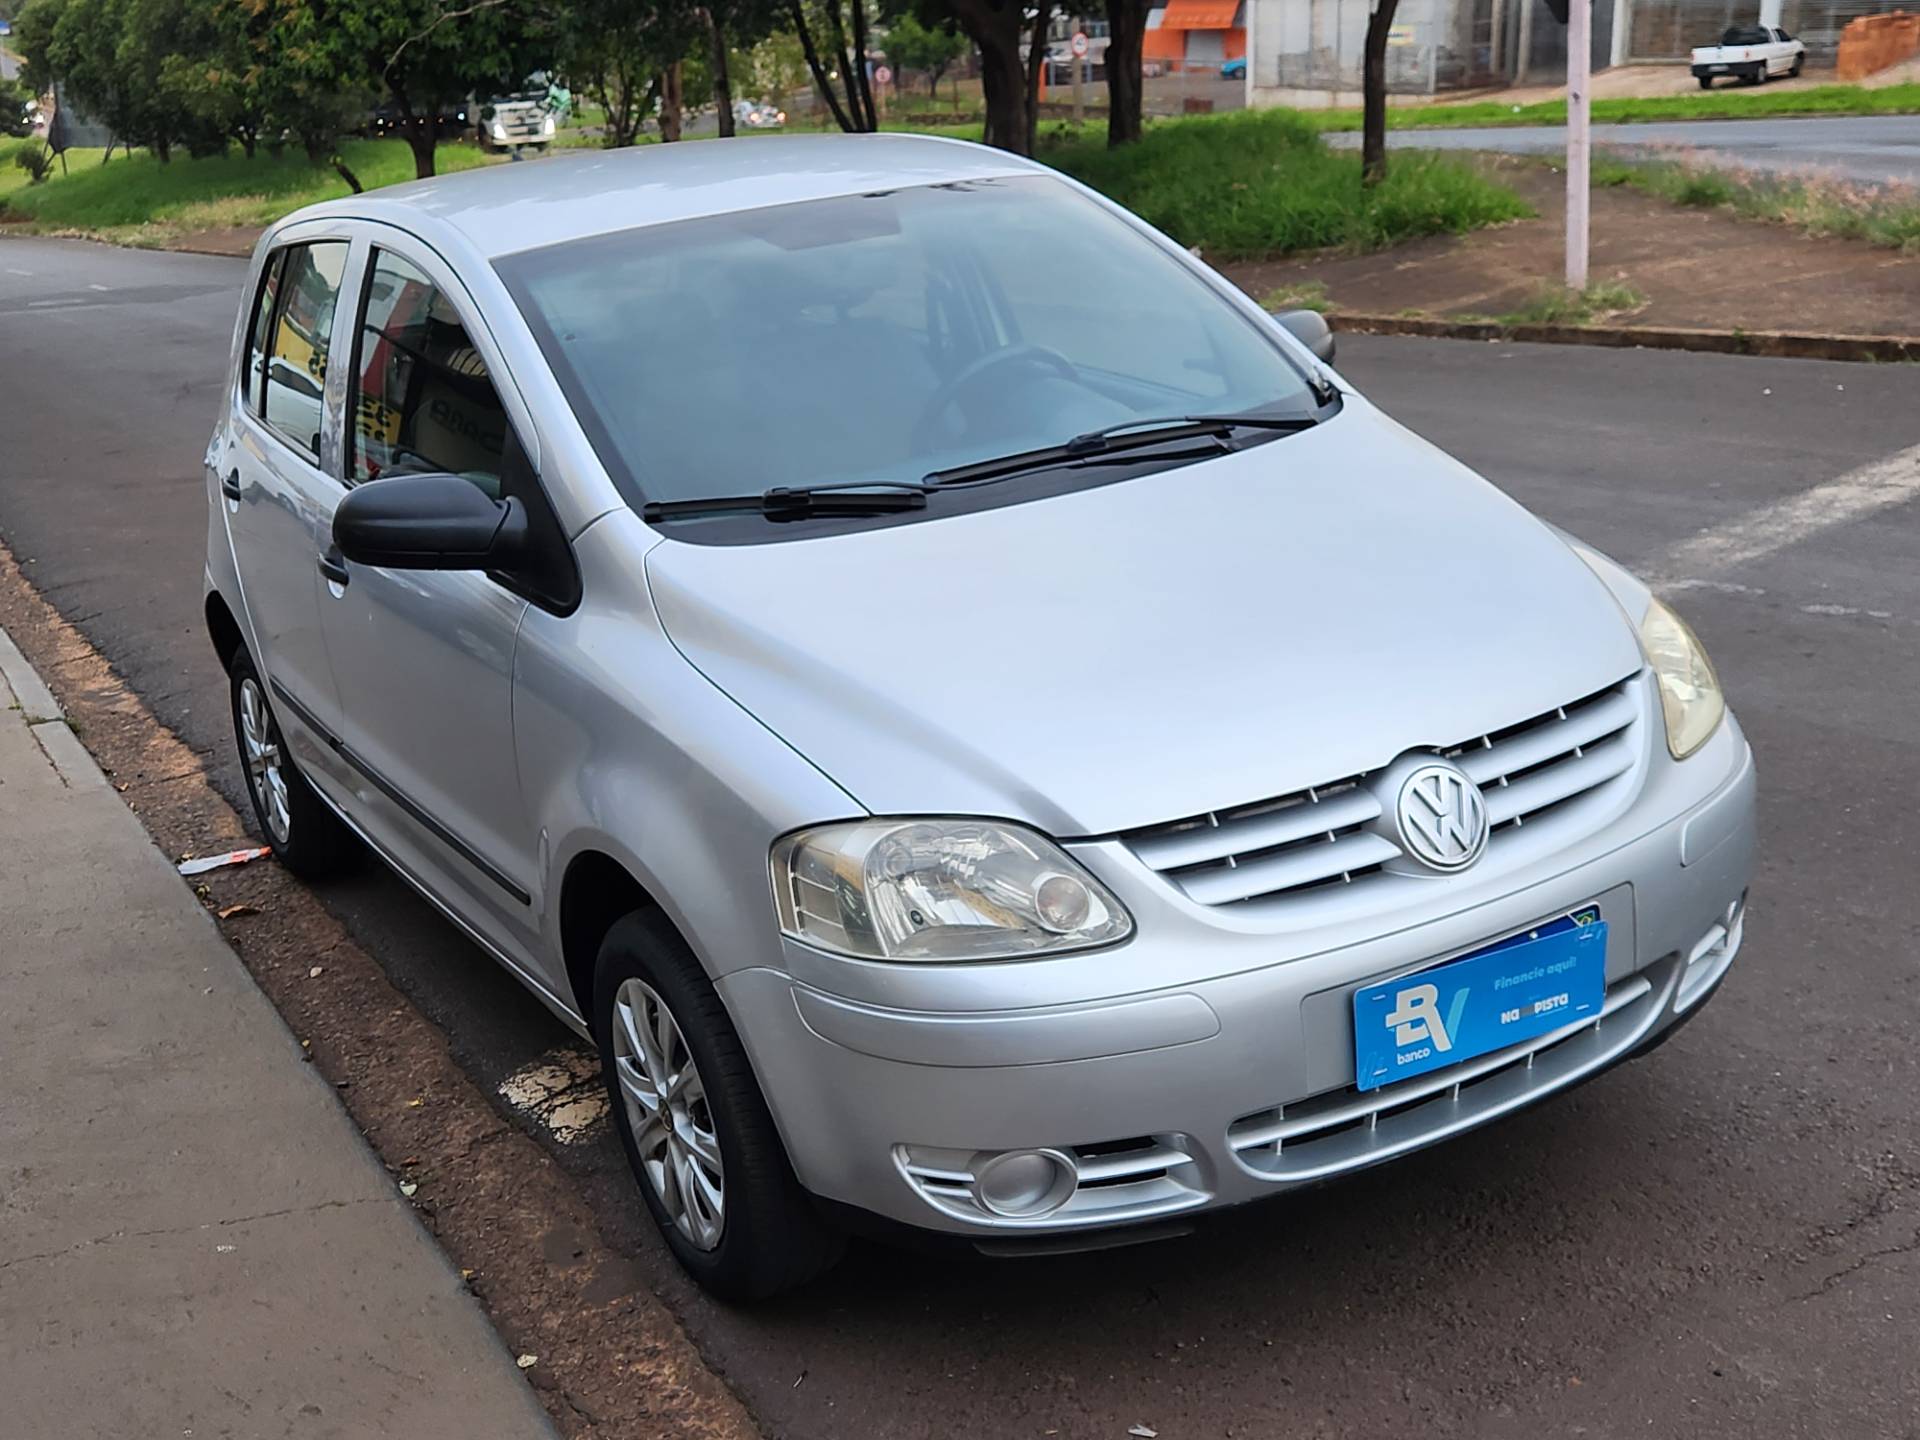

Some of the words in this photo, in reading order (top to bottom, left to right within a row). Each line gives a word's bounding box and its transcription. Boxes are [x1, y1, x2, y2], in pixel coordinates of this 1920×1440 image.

[1494, 966, 1545, 991] Financie
[1386, 984, 1471, 1052] BV
[1396, 1047, 1431, 1066] banco
